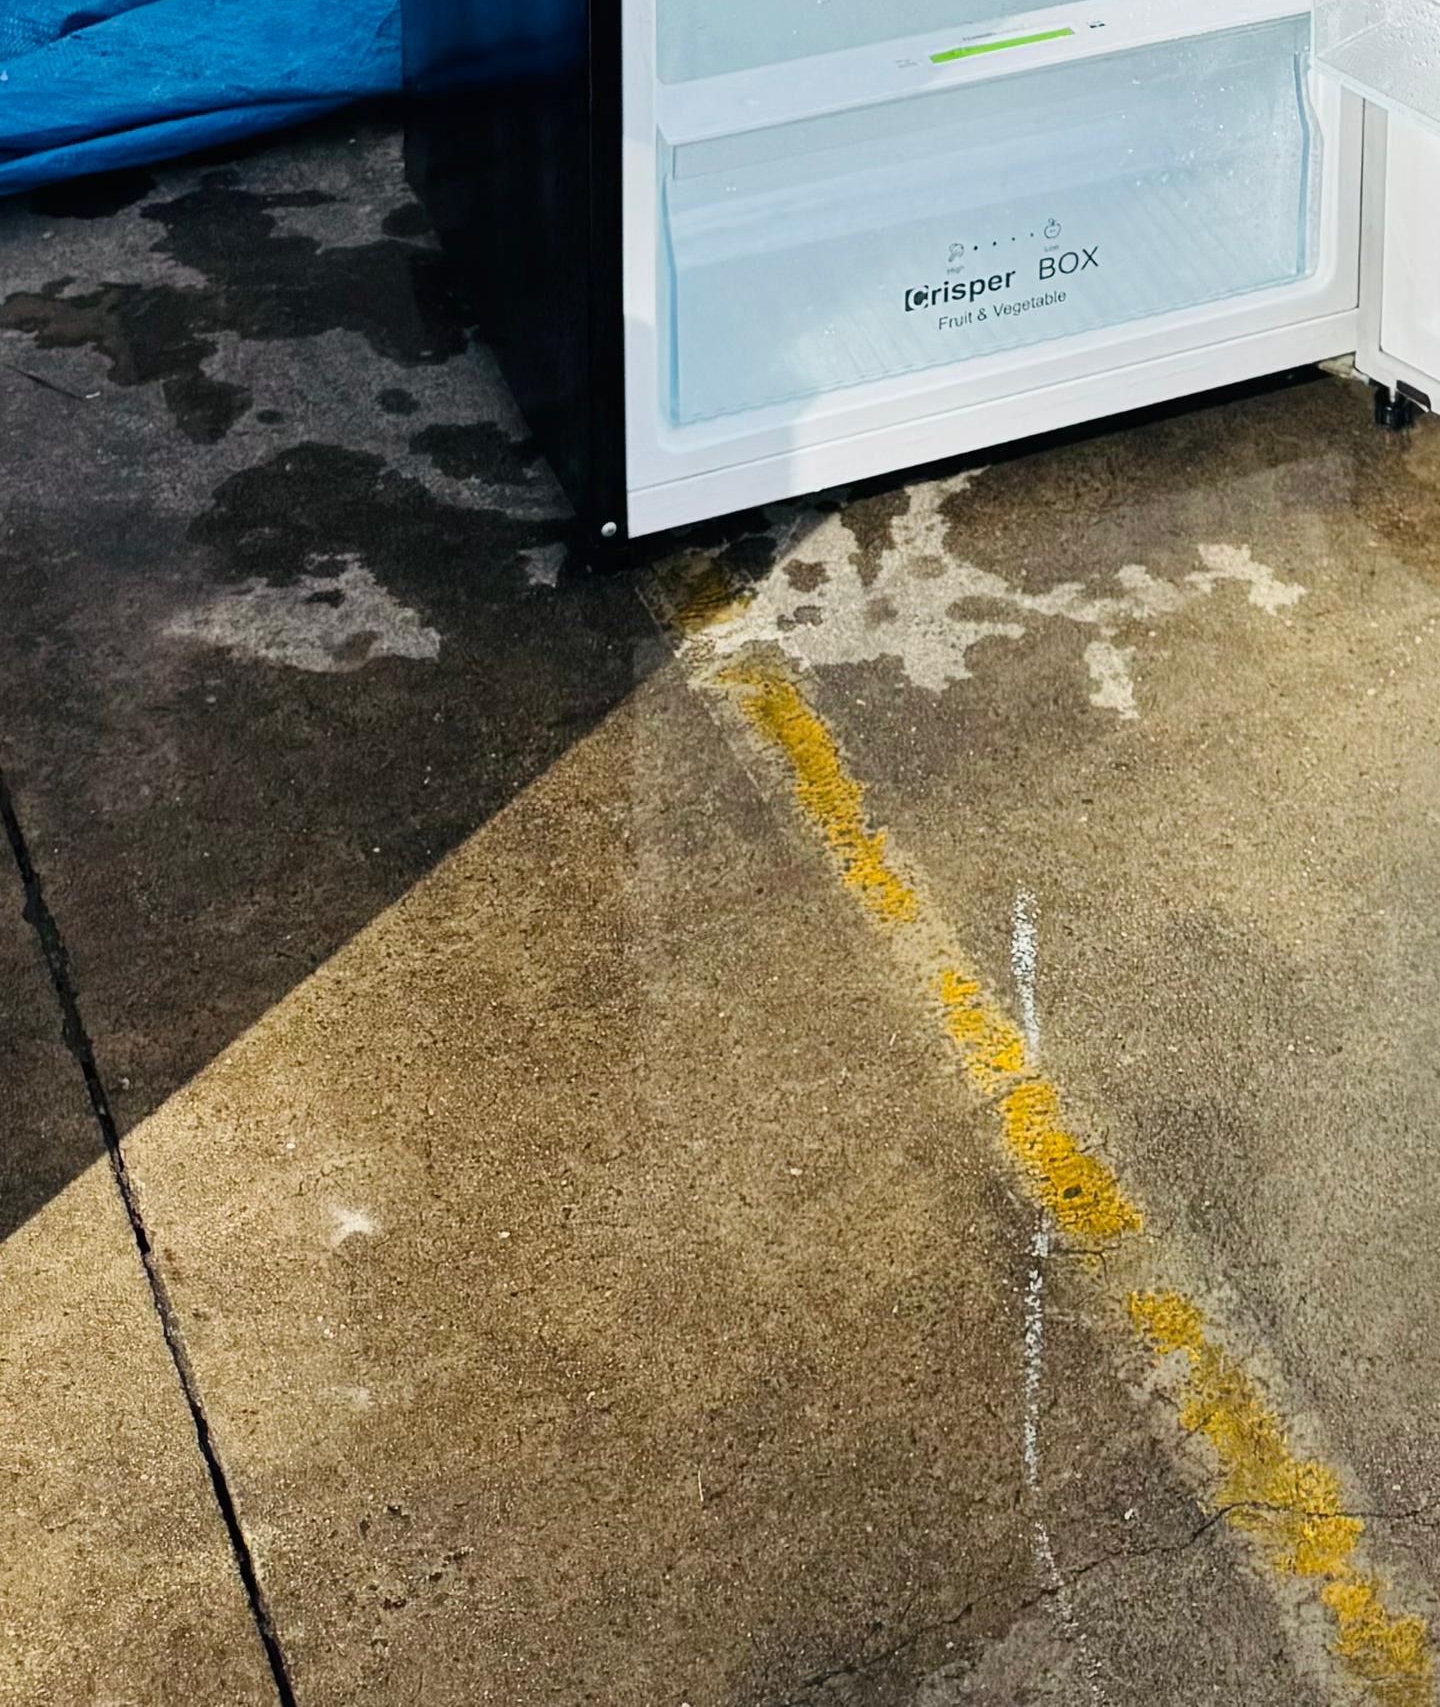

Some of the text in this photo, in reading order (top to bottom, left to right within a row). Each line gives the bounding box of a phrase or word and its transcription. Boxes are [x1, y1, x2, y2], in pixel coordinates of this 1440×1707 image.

[905, 245, 1099, 312] Crisper BOX
[938, 289, 1067, 331] Fruit & Vegetable
